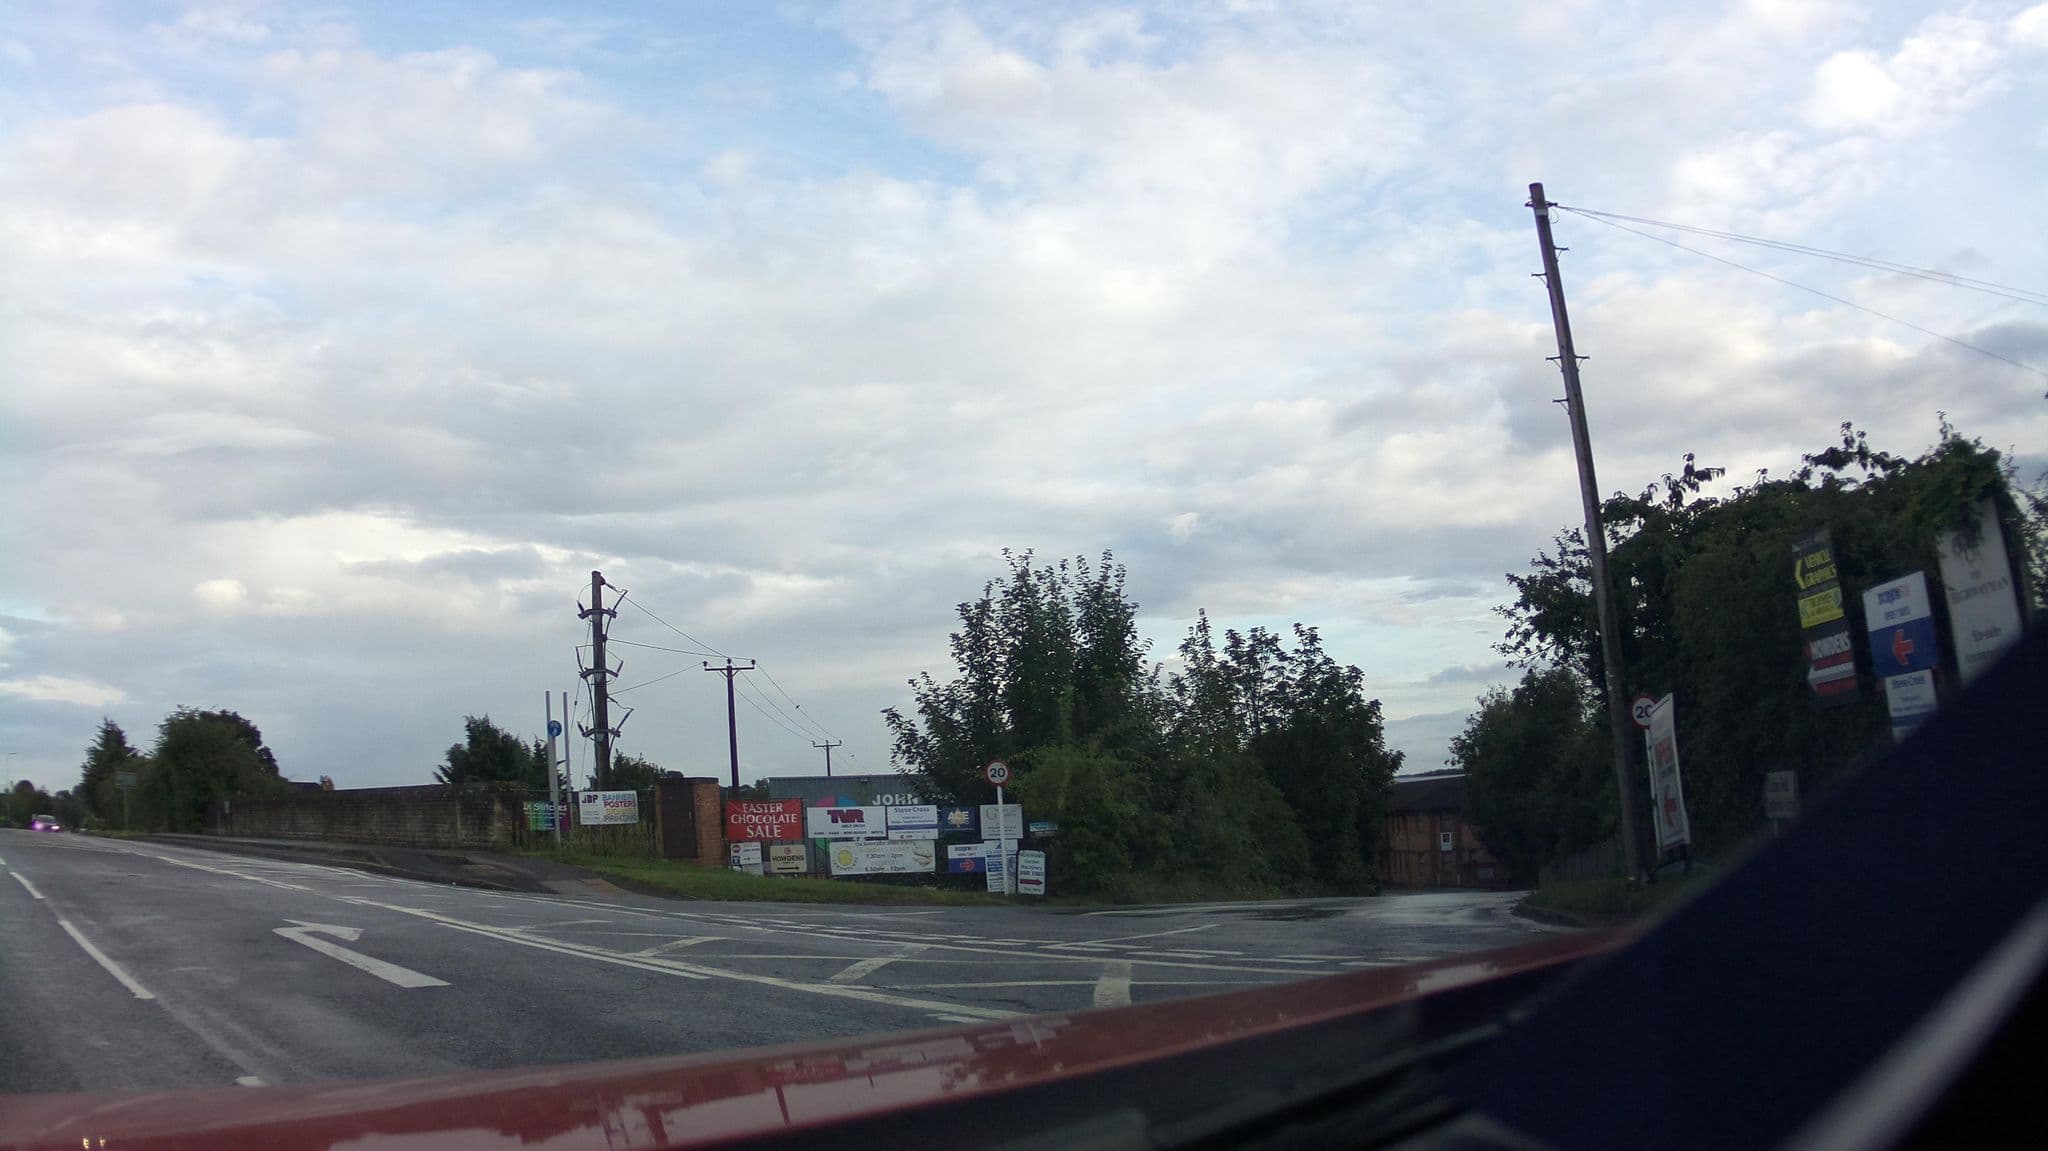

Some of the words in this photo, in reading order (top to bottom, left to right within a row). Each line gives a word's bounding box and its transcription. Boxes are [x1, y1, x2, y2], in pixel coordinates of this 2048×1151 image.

[1635, 705, 1653, 719] 20
[989, 767, 1006, 778] 20
[872, 793, 919, 806] JOHN
[742, 803, 784, 813] EASTER
[730, 813, 798, 824] CHOCOLATE
[827, 809, 865, 824] TVR
[746, 825, 782, 838] SALE
